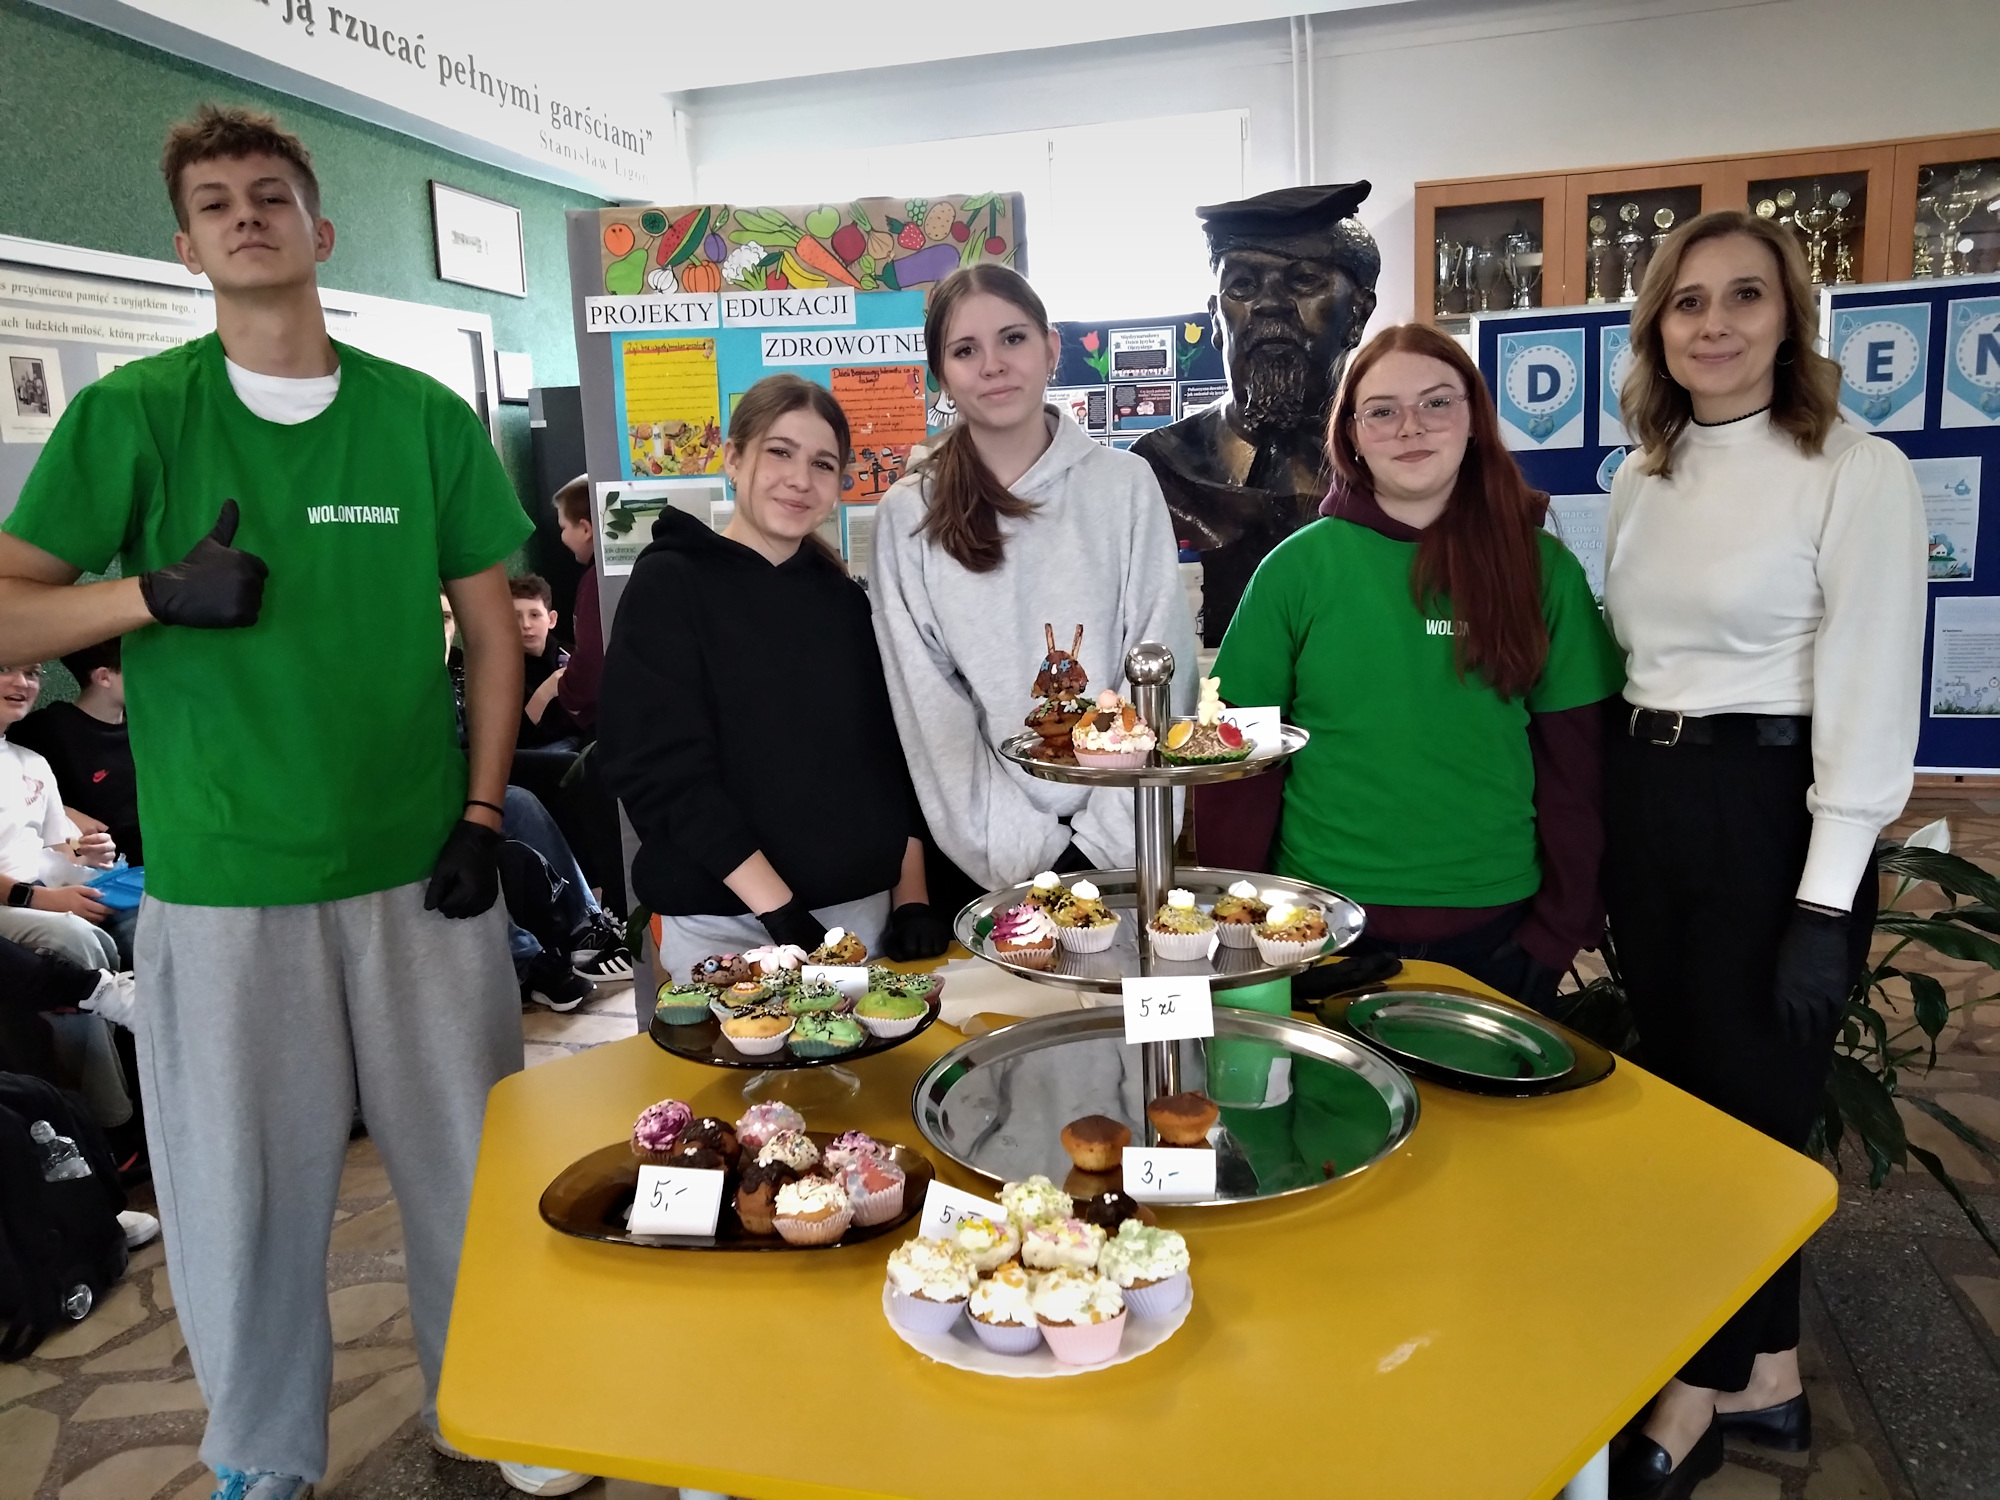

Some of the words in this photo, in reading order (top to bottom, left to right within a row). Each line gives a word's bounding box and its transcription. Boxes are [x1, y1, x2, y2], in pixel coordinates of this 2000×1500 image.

[329, 4, 427, 70] rzucać
[437, 52, 541, 115] pełnymi
[11, 282, 73, 299] przyćmiewa
[76, 291, 109, 304] pamięć
[113, 296, 118, 304] z
[121, 296, 168, 310] wyjątkiem
[590, 302, 714, 325] PROJEKTY
[725, 294, 849, 318] EDUKACJI
[25, 318, 69, 333] ludzkich
[109, 326, 134, 340] którą
[136, 331, 183, 345] przekazują
[1865, 340, 1894, 383] E
[1527, 364, 1562, 403] D
[307, 505, 400, 524] WOLONTARIAT
